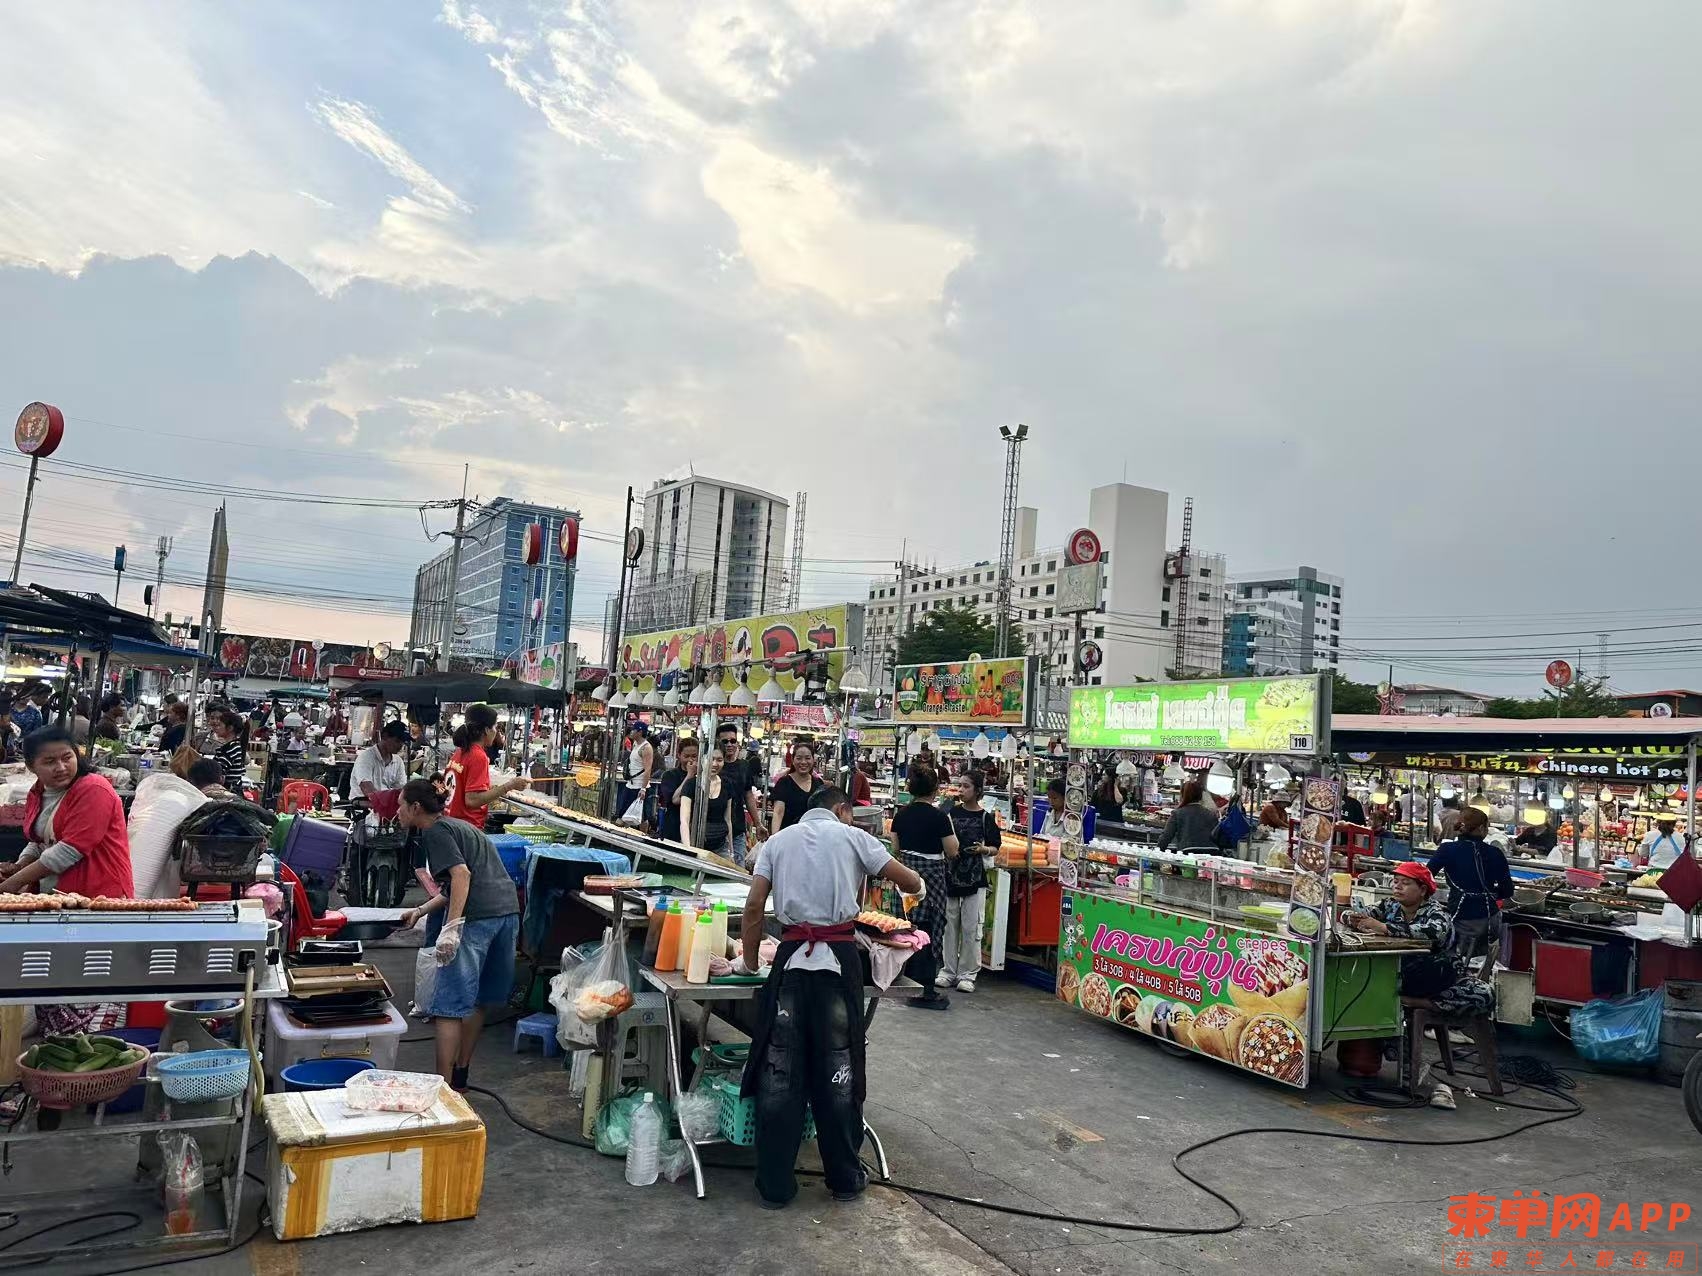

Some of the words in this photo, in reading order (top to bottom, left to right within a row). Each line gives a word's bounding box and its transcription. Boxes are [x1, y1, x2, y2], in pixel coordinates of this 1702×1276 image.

[1294, 737, 1306, 748] 110
[1538, 760, 1609, 774] Chinese
[1616, 763, 1650, 776] hot
[1236, 937, 1287, 954] crepes
[1090, 924, 1258, 997] เครปญี่ปุ่น
[1094, 959, 1100, 970] 3
[1108, 962, 1124, 977] 30B
[1129, 969, 1135, 981] 4
[1145, 974, 1162, 990] 40B
[1168, 981, 1174, 993] 5
[1184, 986, 1201, 1002] 50B
